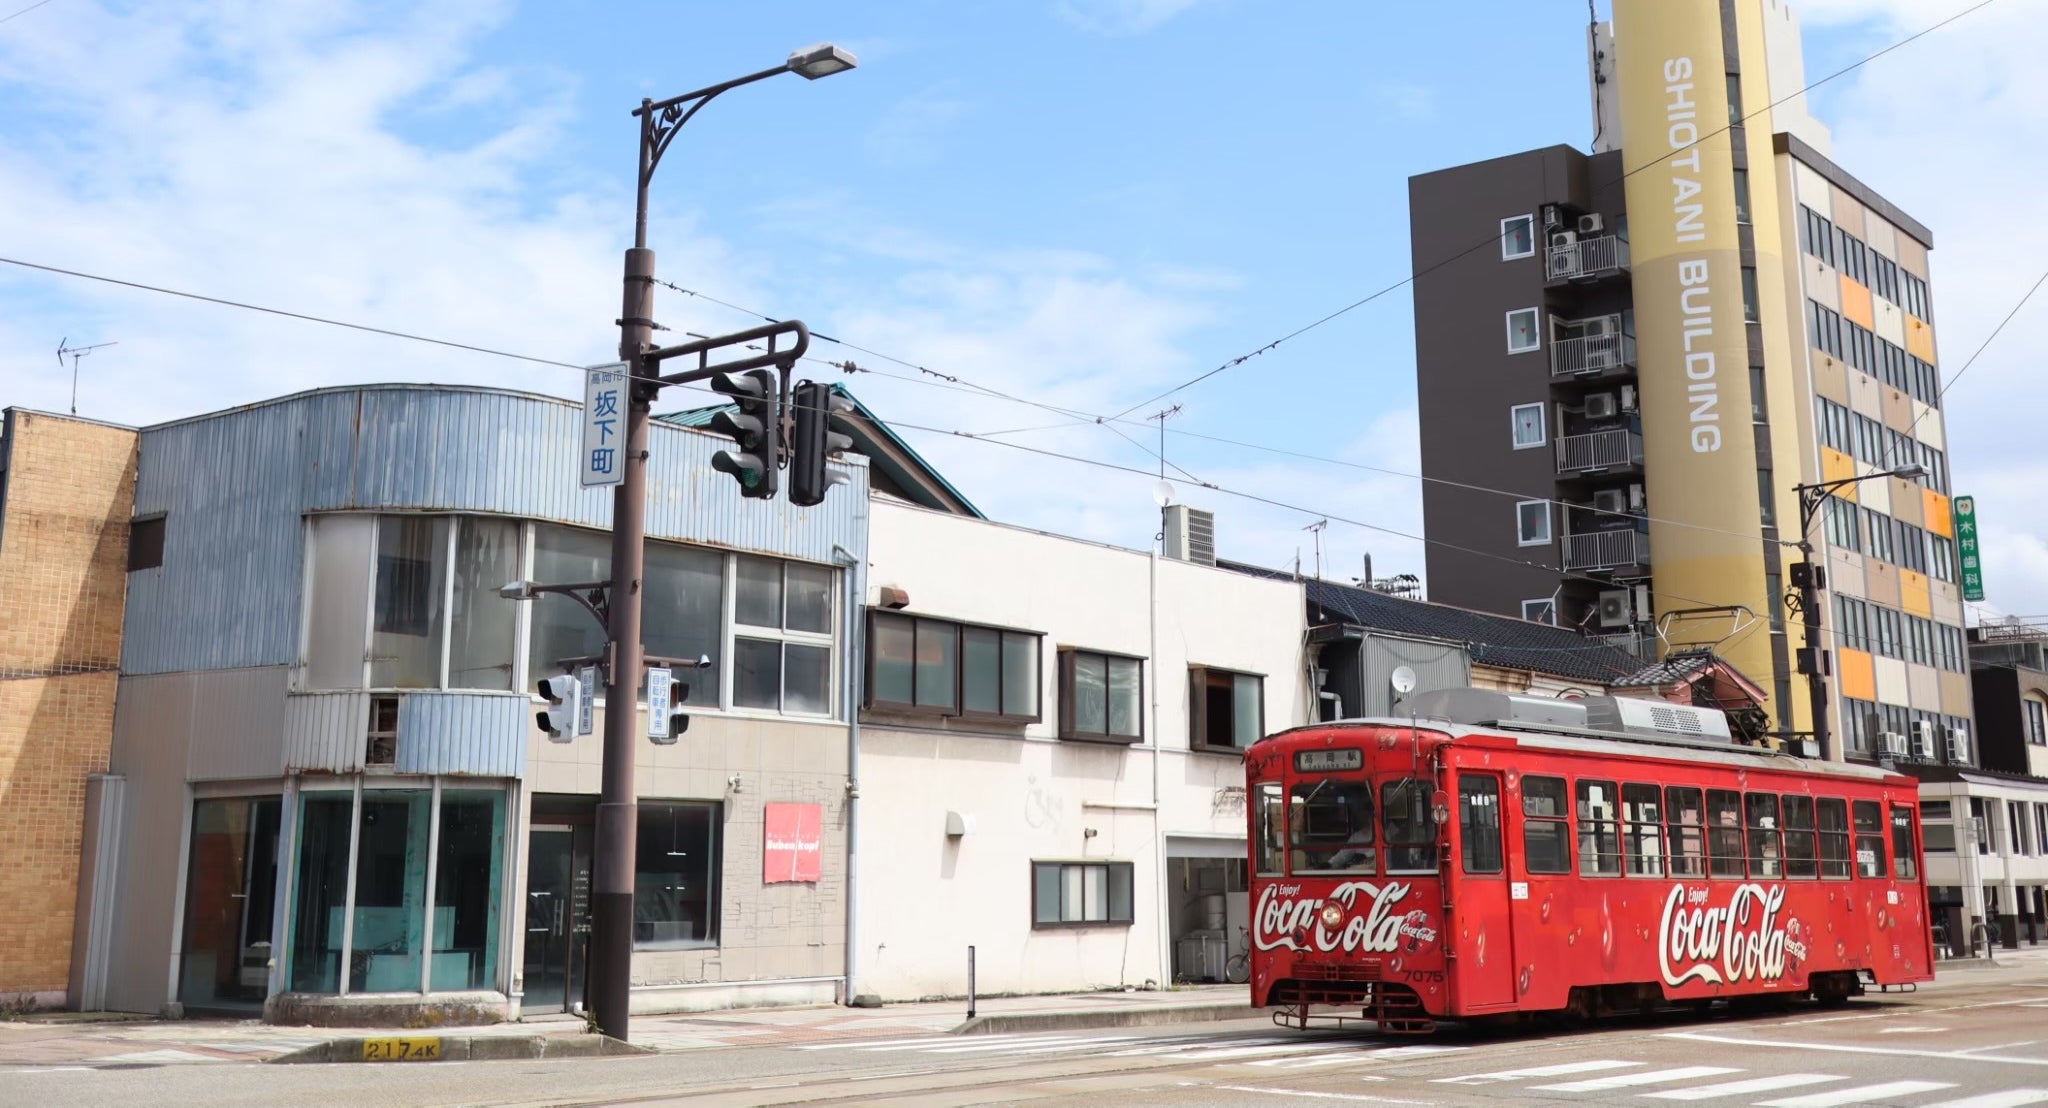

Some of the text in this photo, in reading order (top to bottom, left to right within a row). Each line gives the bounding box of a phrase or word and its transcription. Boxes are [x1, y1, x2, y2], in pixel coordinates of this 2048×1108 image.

[1663, 56, 1722, 454] SHIOTANI BUILDING
[591, 389, 618, 474] 坂下町
[1960, 520, 1979, 587] 木村歯科
[1279, 883, 1301, 896] Enjoy!
[1687, 886, 1710, 906] Enjoy!
[1658, 882, 1786, 987] Coca-Cola
[1402, 970, 1445, 983] 7075
